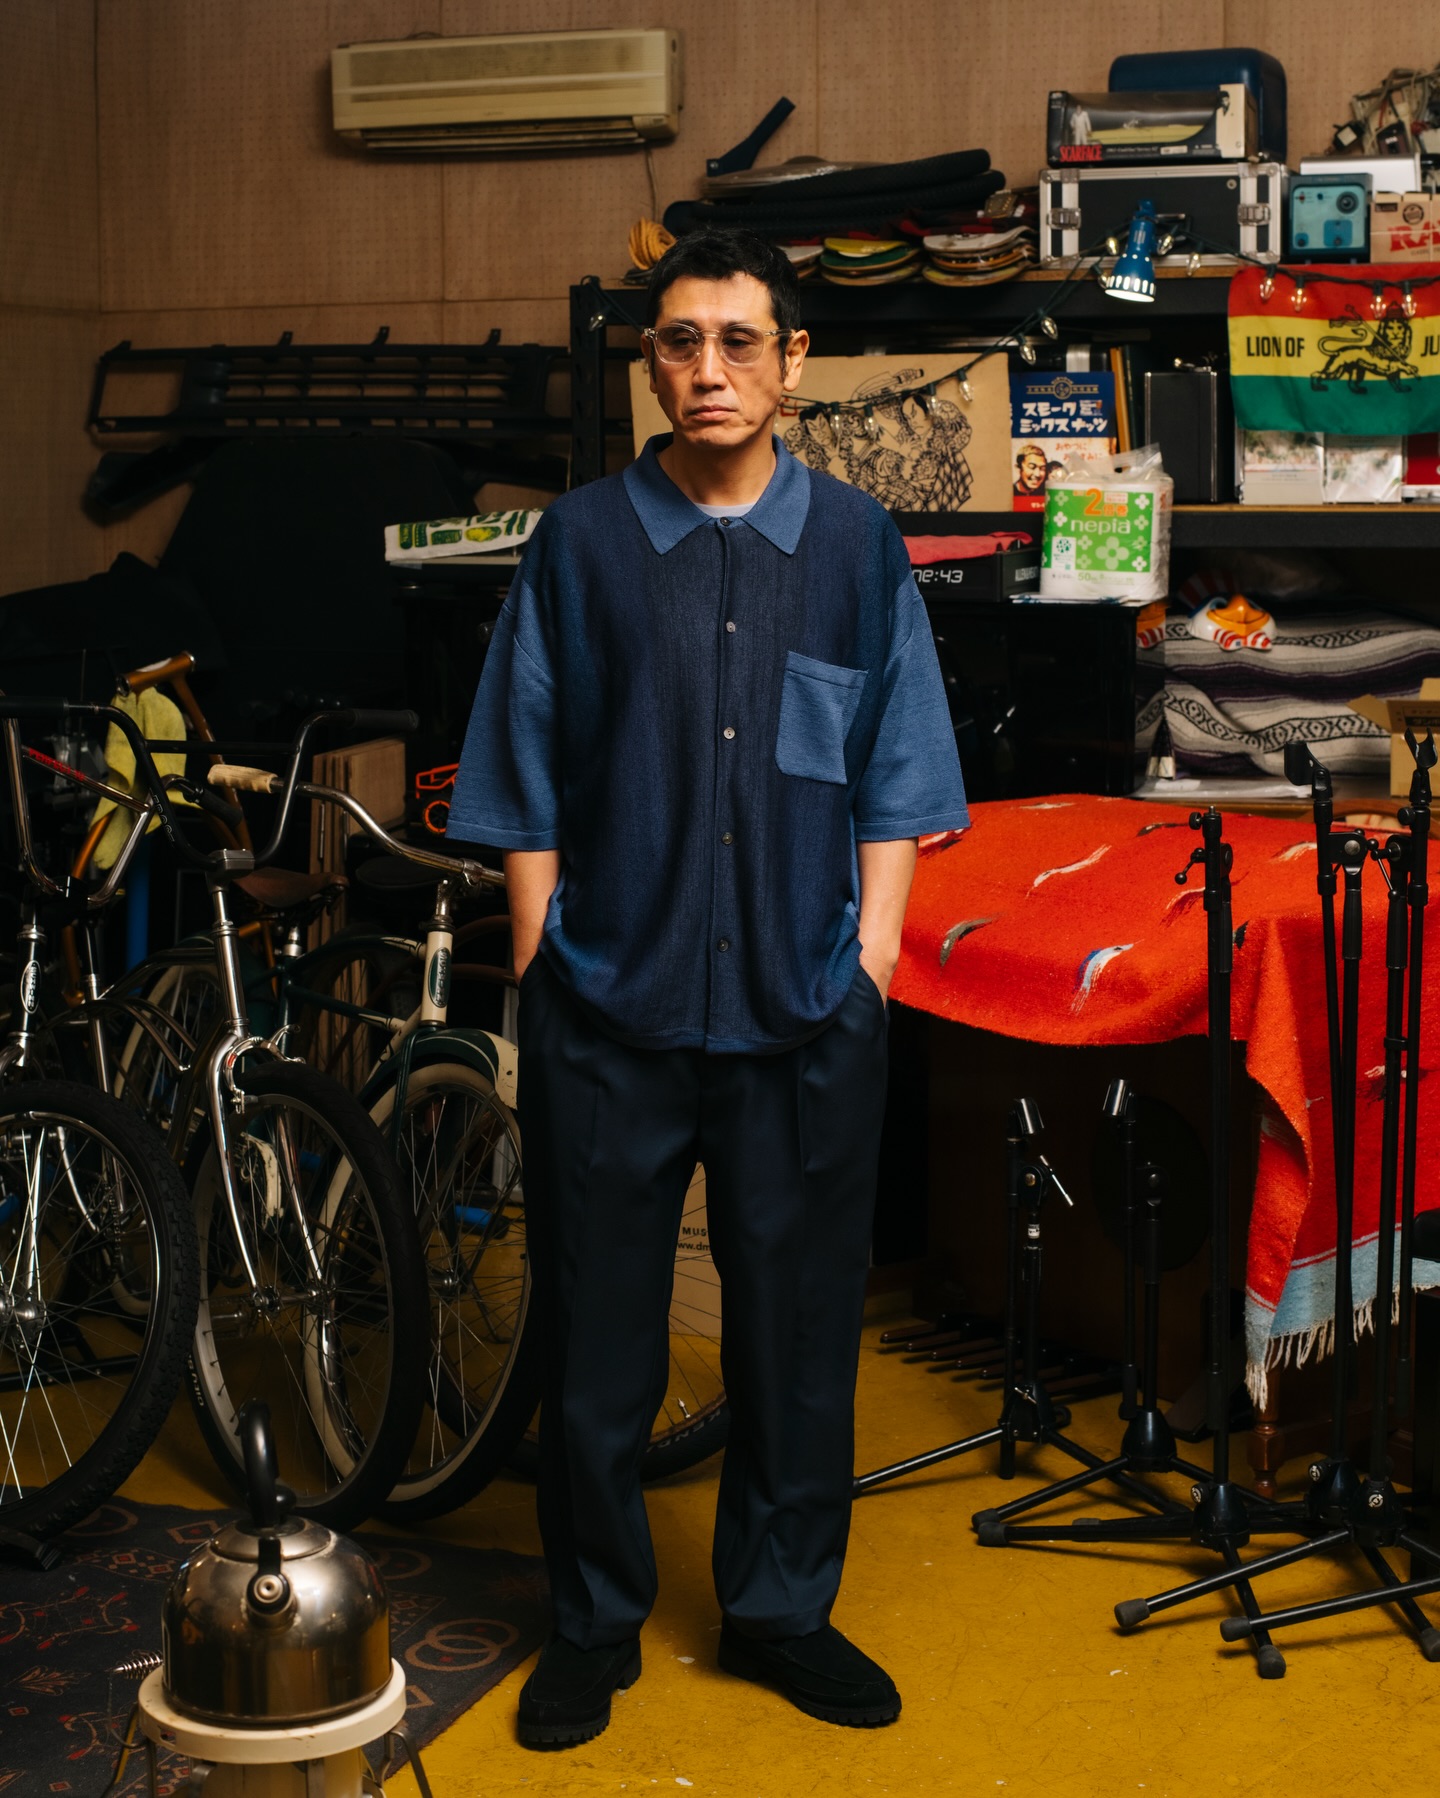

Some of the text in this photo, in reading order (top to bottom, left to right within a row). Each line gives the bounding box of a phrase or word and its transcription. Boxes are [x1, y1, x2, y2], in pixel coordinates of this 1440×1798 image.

[1060, 145, 1103, 162] SCARFACE
[1387, 219, 1440, 252] RA
[1246, 336, 1281, 357] LION
[1285, 337, 1305, 357] OF
[1022, 401, 1077, 417] スモーク
[1071, 518, 1131, 536] nepia
